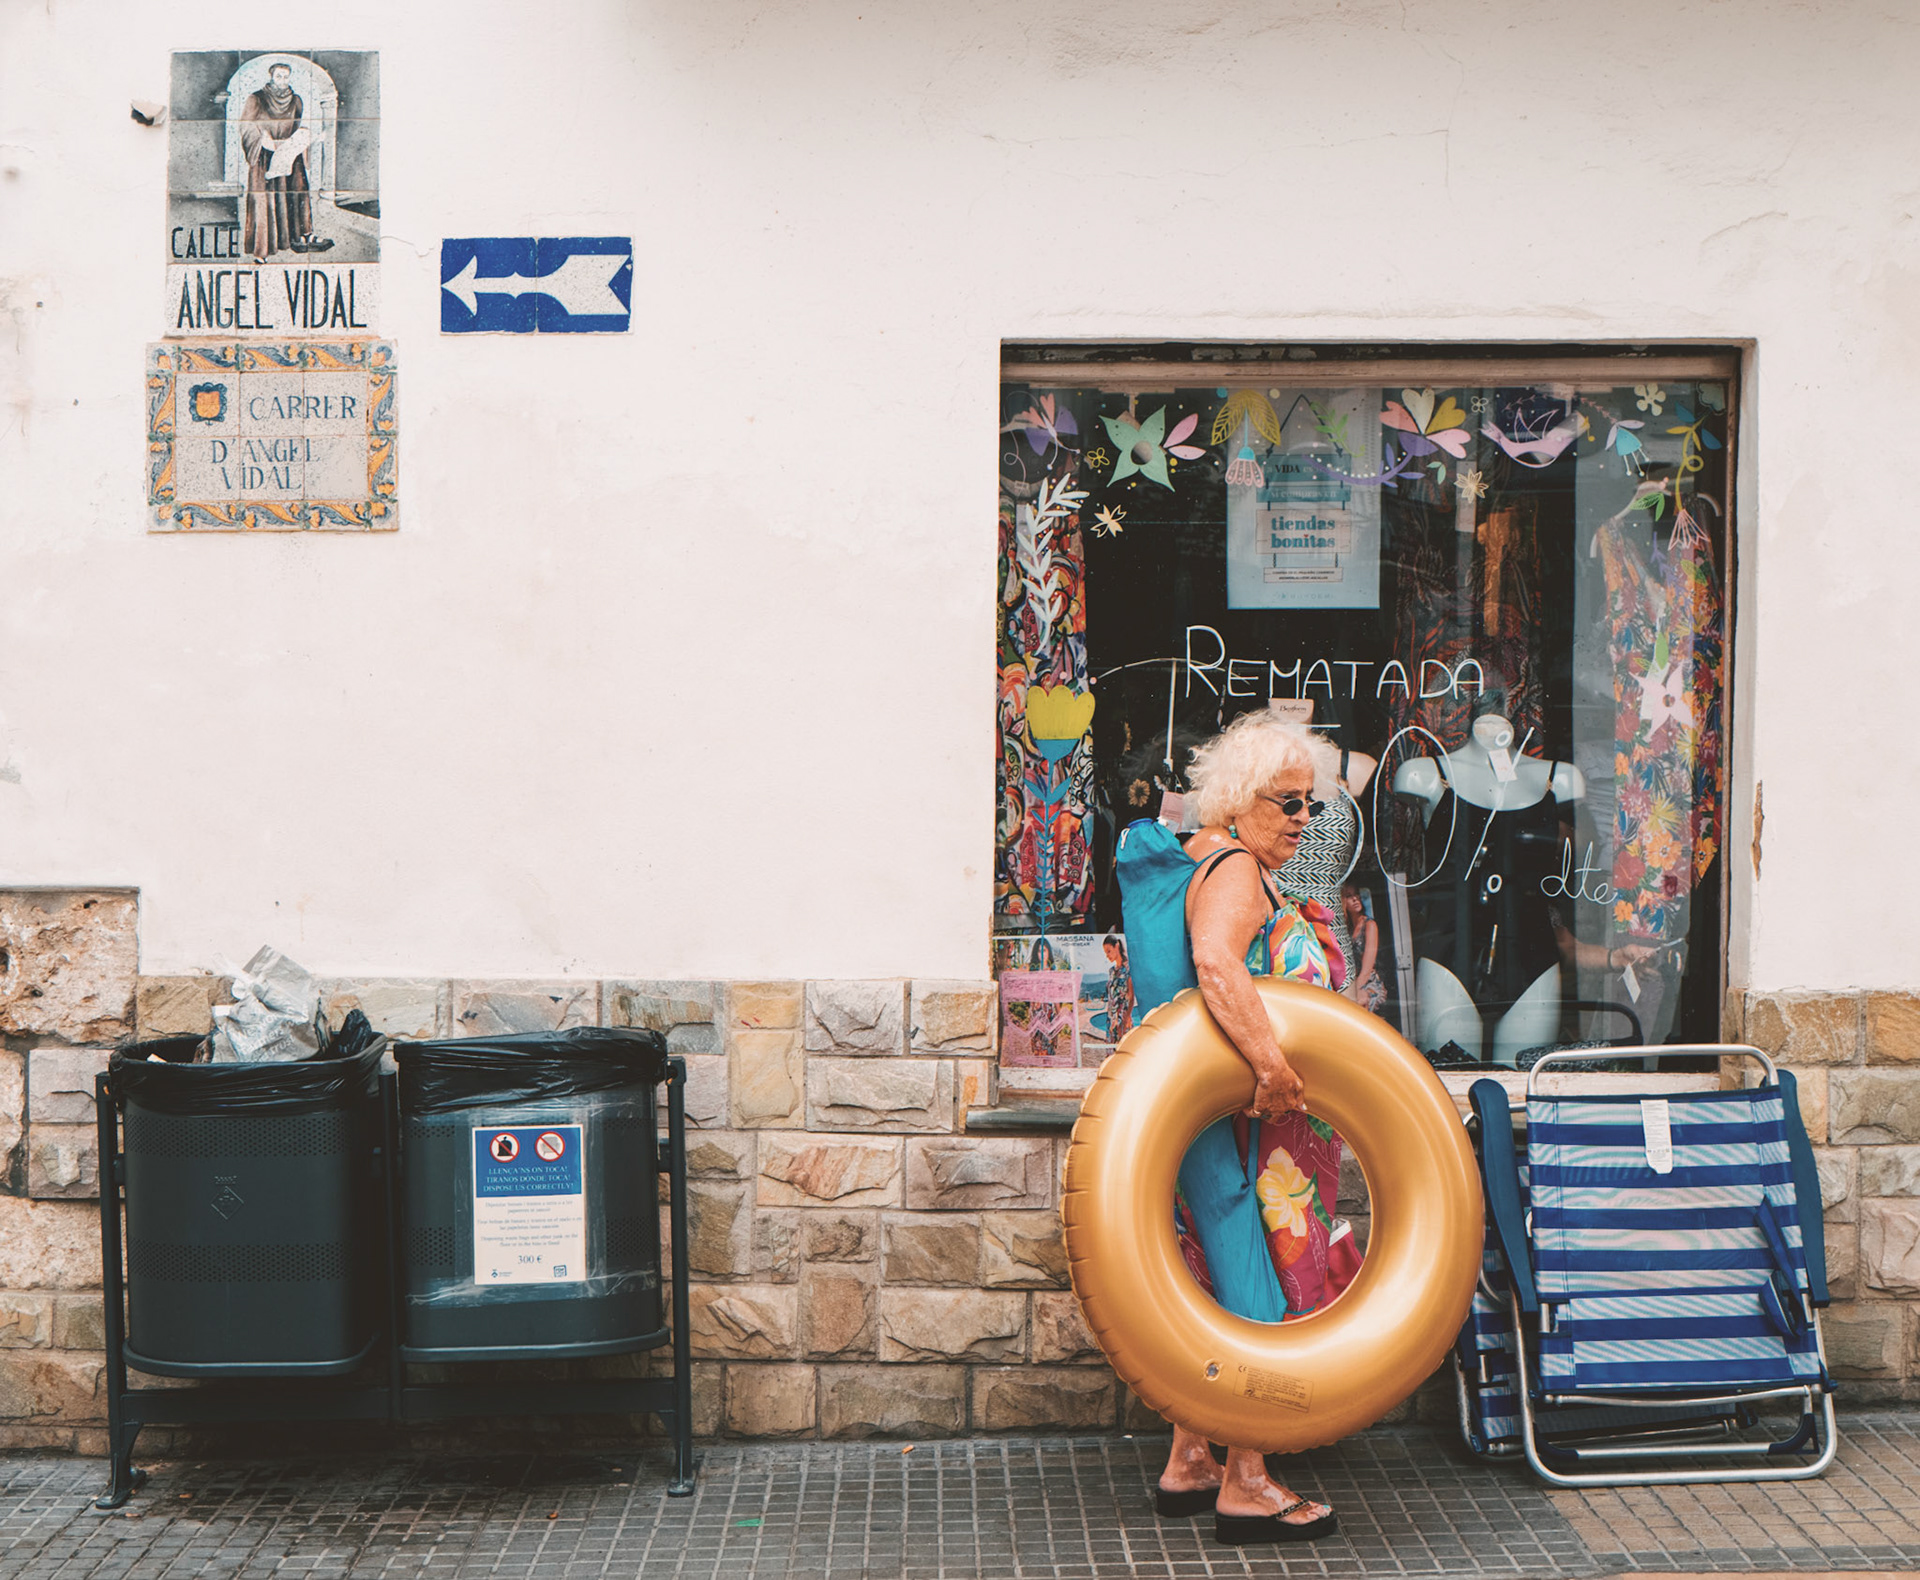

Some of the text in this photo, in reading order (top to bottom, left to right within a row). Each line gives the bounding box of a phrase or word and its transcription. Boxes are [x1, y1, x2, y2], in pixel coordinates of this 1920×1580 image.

[171, 226, 241, 259] CALLE
[176, 269, 367, 329] ANGEL VIDAL
[249, 395, 357, 421] CARRER
[1275, 464, 1300, 473] VIDA
[1271, 515, 1335, 531] tiendas
[1271, 533, 1335, 549] bonitas
[1185, 624, 1485, 700] REMATADA
[1540, 836, 1618, 905] dte
[1056, 935, 1095, 943] MASSANA
[531, 1166, 543, 1174] ON
[545, 1165, 568, 1173] TOCA!
[548, 1173, 571, 1181] TOCA!
[483, 1184, 512, 1192] DISPOSE
[526, 1182, 574, 1190] CORRECTLY!
[518, 1254, 543, 1264] 300 €
